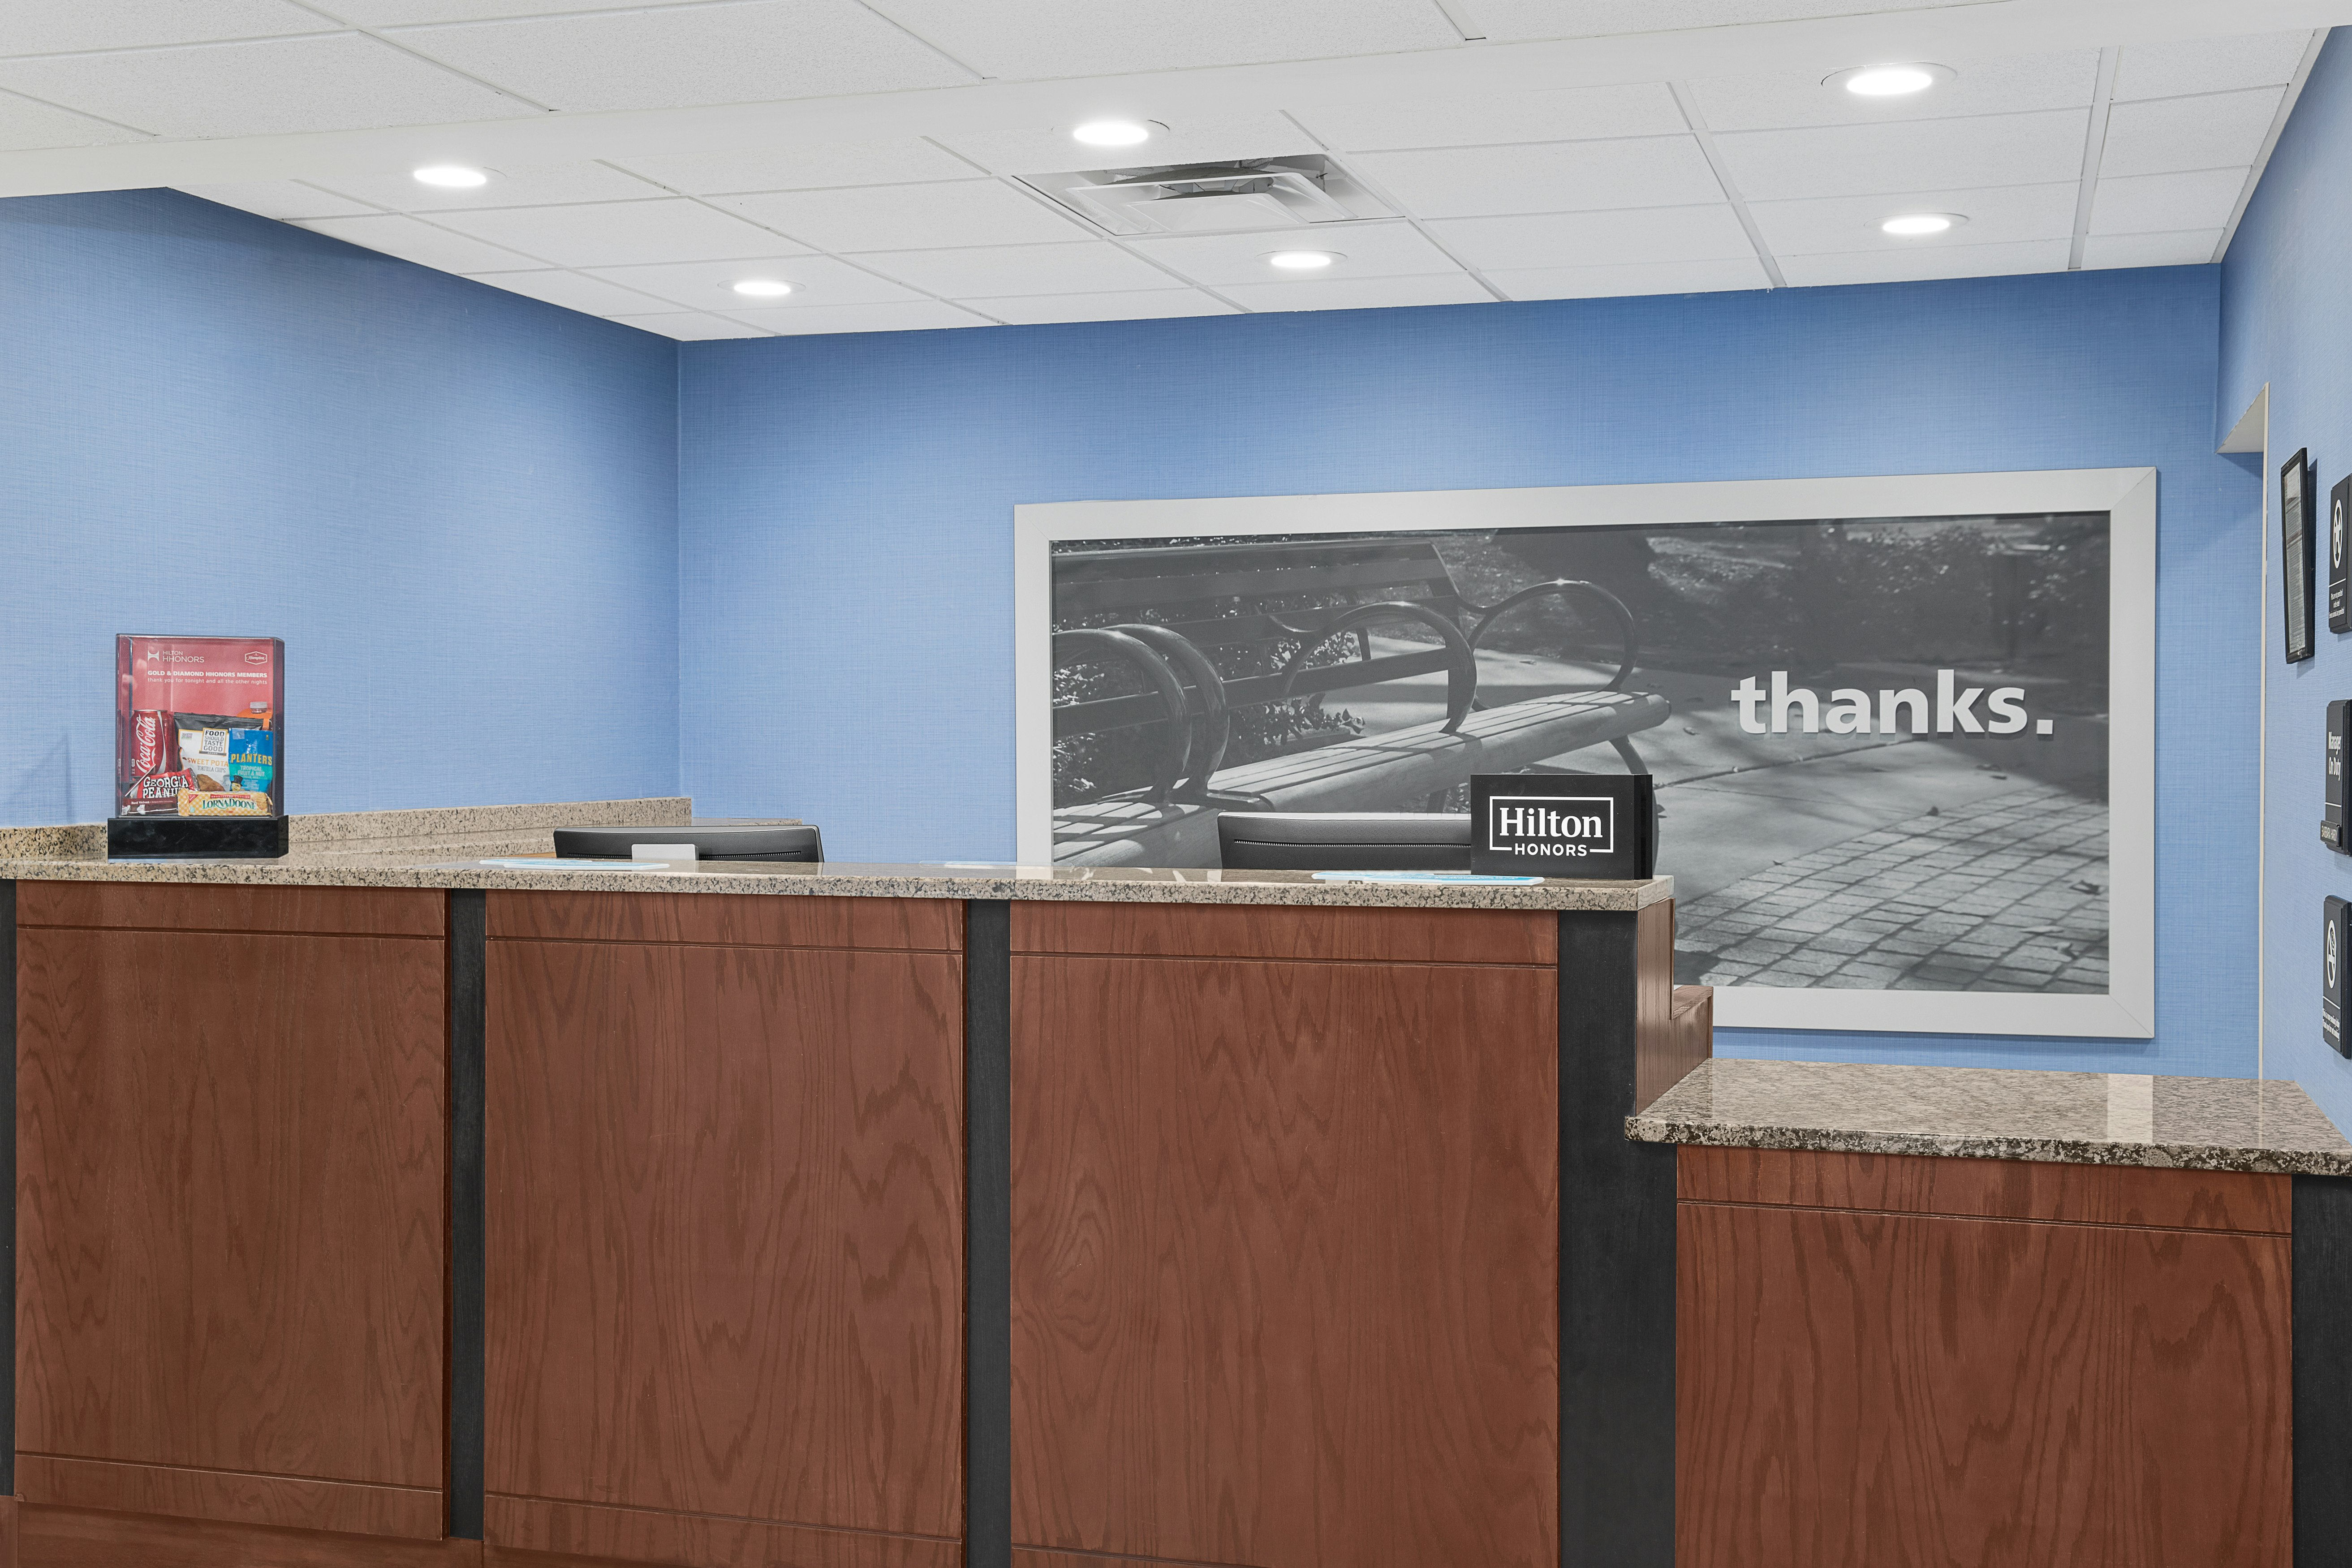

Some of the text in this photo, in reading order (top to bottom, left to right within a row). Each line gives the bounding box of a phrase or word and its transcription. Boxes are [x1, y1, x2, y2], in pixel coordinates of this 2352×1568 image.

[1731, 669, 2053, 734] thanks.
[2328, 732, 2341, 754] Manager
[231, 754, 272, 766] PLANTERS
[2329, 757, 2341, 781] On Duty
[143, 775, 189, 788] GEORGIA
[202, 798, 257, 810] LORNA DOONE
[1499, 807, 1603, 838] Hilton
[1515, 843, 1587, 857] HONORS
